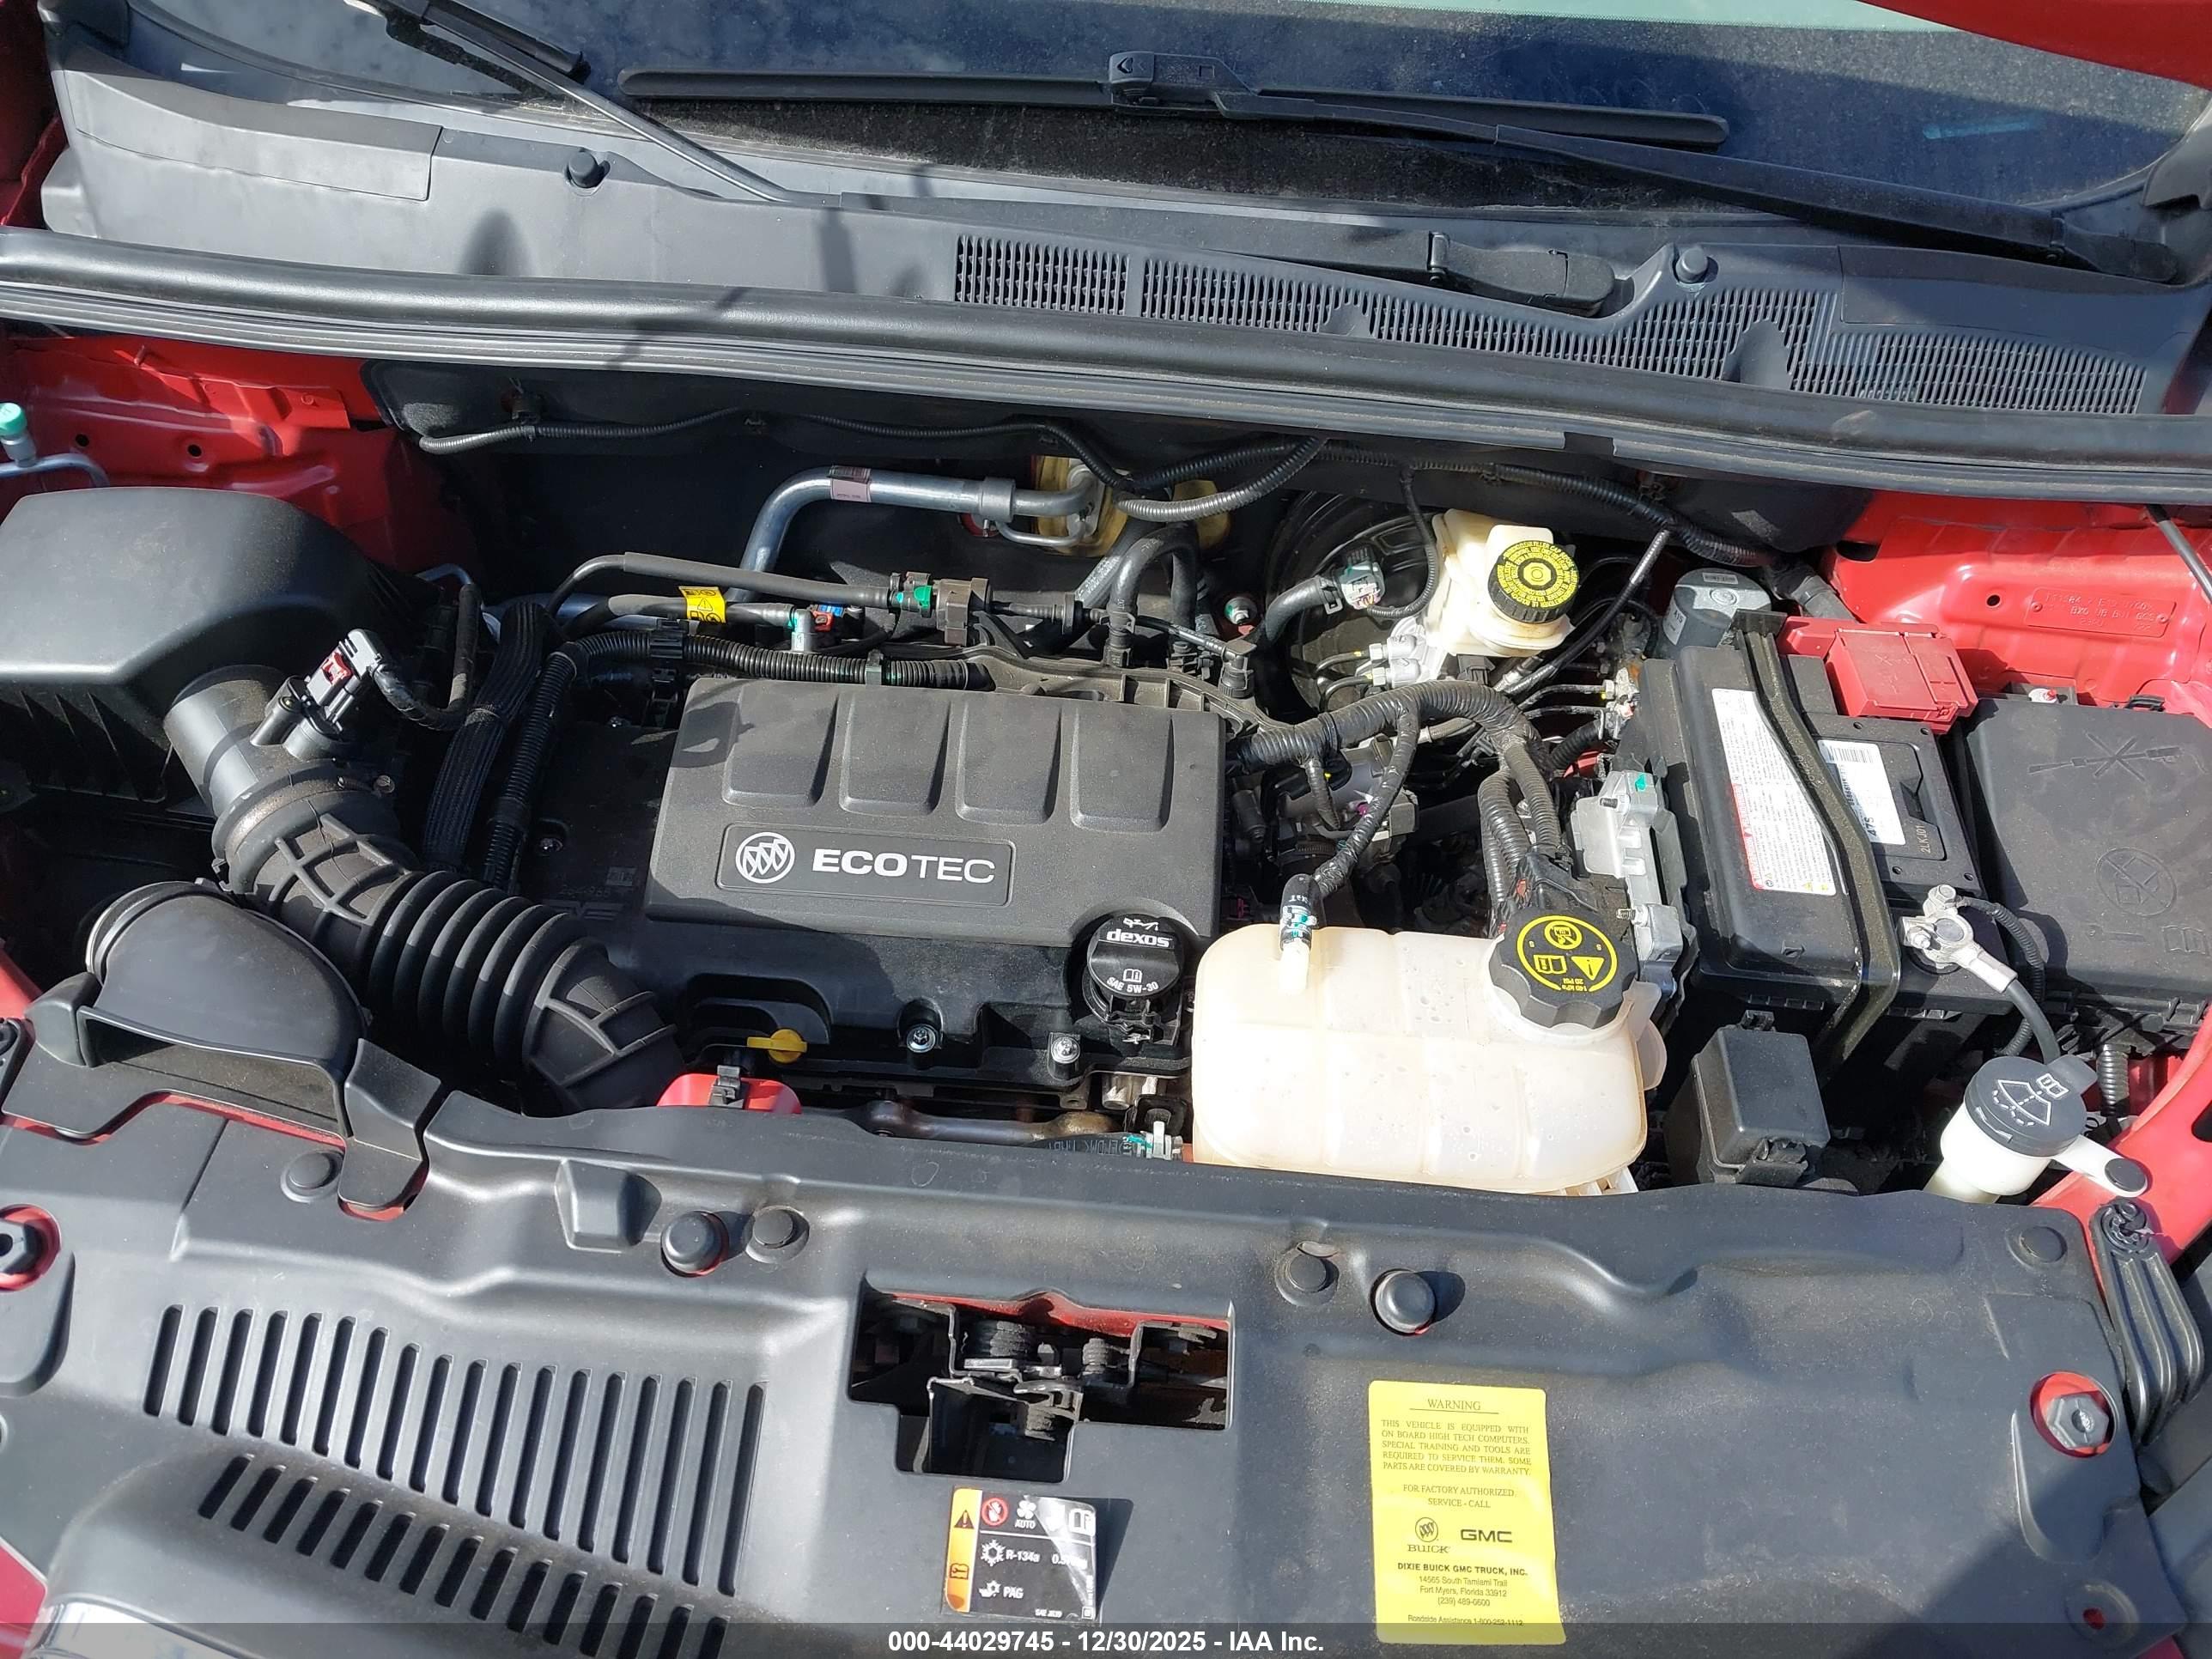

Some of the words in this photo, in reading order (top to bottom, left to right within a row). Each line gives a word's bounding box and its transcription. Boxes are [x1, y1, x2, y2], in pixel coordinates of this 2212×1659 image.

[812, 848, 995, 884] ECOTEC
[1106, 928, 1170, 948] dexos
[1106, 976, 1124, 991] SAE
[1127, 981, 1159, 994] 5W-30
[1427, 1399, 1481, 1411] WARNING
[1406, 1420, 1441, 1430] VEHICLE
[1462, 1423, 1501, 1432] EQUIPPED
[1508, 1425, 1528, 1434] WITH
[1397, 1431, 1425, 1439] BOARD
[1429, 1432, 1449, 1441] HIGH
[1453, 1433, 1474, 1442] TECH
[1478, 1434, 1529, 1444] COMPUTERS.
[1382, 1440, 1415, 1449] SPECIAL
[1419, 1442, 1459, 1451] TRAINING
[1484, 1445, 1510, 1454] TOOLS
[1382, 1451, 1424, 1461] REQUIRED
[1442, 1454, 1475, 1462] SERVICE
[1479, 1455, 1504, 1464] THEM.
[1383, 1462, 1407, 1470] PARTS
[1427, 1463, 1467, 1473] COVERED
[1482, 1466, 1531, 1476] WARRANTY.
[1403, 1484, 1419, 1492] FOR
[1421, 1486, 1458, 1494] FACTORY
[1428, 1498, 1462, 1507] SERVICE
[1468, 1499, 1491, 1508] CALL
[1014, 1519, 1036, 1529] AUTO
[1460, 1528, 1512, 1543] GMC
[1407, 1544, 1449, 1553] BUICK
[1006, 1549, 1040, 1563] R-134a
[1397, 1562, 1421, 1571] DIXIE
[1423, 1564, 1450, 1572] BUICK
[1453, 1565, 1473, 1573] GMC
[1474, 1565, 1508, 1576] TRUCK,
[1510, 1567, 1528, 1576] INC.
[1442, 1577, 1462, 1585] South
[1463, 1577, 1492, 1587] Tamiami
[1493, 1578, 1508, 1587] Trail
[1003, 1587, 1024, 1599] PAG
[1419, 1585, 1433, 1594] Fort
[1435, 1587, 1459, 1596] Myers,
[1460, 1587, 1484, 1596] Florida
[1486, 1588, 1507, 1597] 33912
[1437, 1596, 1455, 1607] (239)
[1407, 1614, 1437, 1623] Roadside
